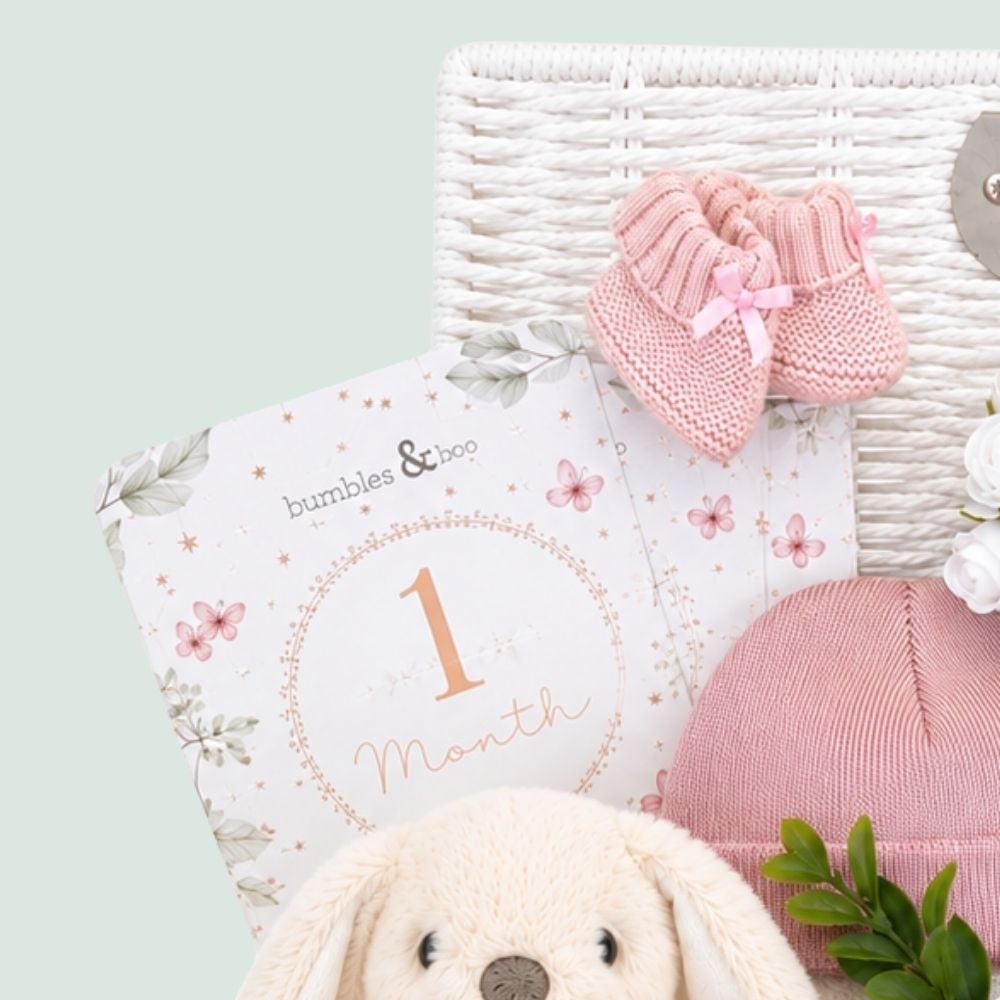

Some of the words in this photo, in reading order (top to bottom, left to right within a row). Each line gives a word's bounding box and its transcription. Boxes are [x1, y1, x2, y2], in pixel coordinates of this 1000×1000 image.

[282, 467, 396, 519] bumbles
[397, 439, 438, 479] &
[435, 438, 479, 465] boo
[399, 566, 486, 703] 1
[353, 686, 592, 795] Month
